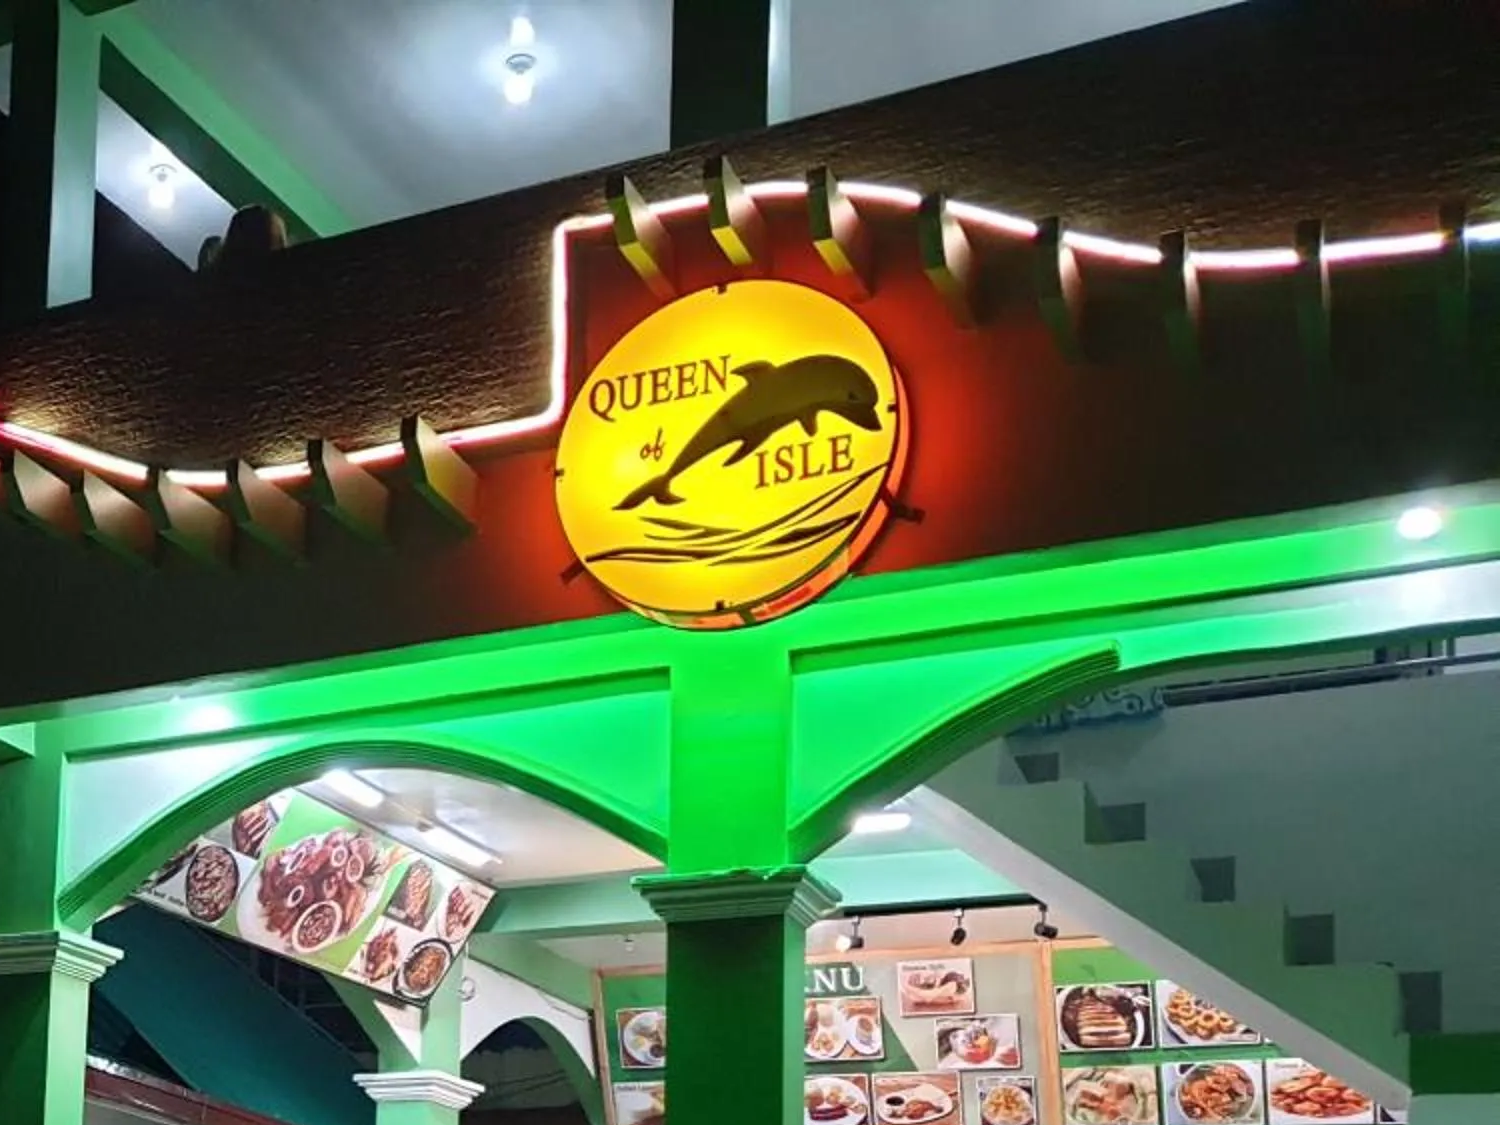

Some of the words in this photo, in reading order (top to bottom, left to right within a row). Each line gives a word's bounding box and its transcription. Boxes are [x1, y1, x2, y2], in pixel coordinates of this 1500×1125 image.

[588, 354, 731, 423] QUEEN
[639, 427, 666, 461] of
[754, 434, 855, 490] ISLE
[804, 967, 865, 993] NU
